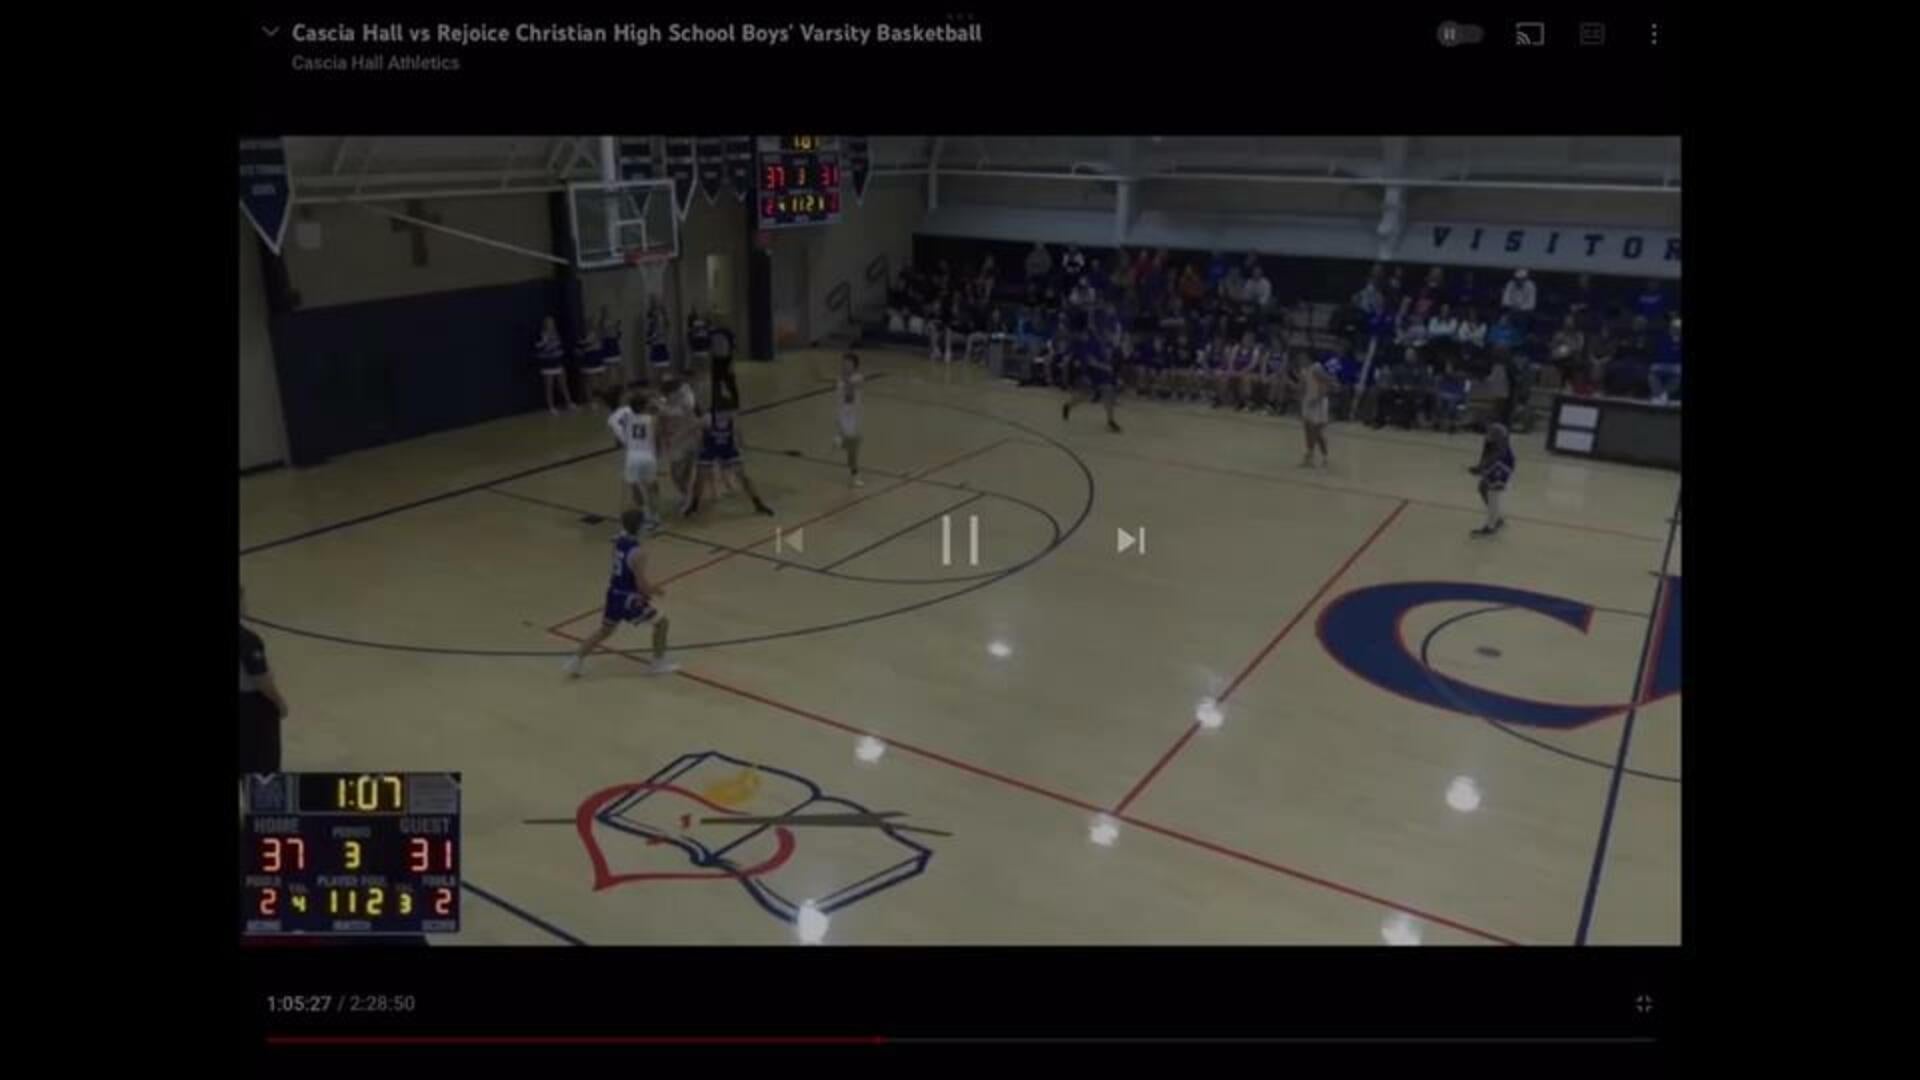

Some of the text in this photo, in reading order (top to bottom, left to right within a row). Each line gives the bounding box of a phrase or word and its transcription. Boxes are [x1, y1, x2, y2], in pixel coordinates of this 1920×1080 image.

[337, 774, 402, 811] 1:07
[261, 837, 305, 872] 37
[343, 840, 362, 870] 3
[409, 837, 452, 872] 31
[259, 888, 278, 915] 2
[291, 894, 307, 913] 4
[399, 893, 412, 914] 3
[433, 887, 452, 915] 2
